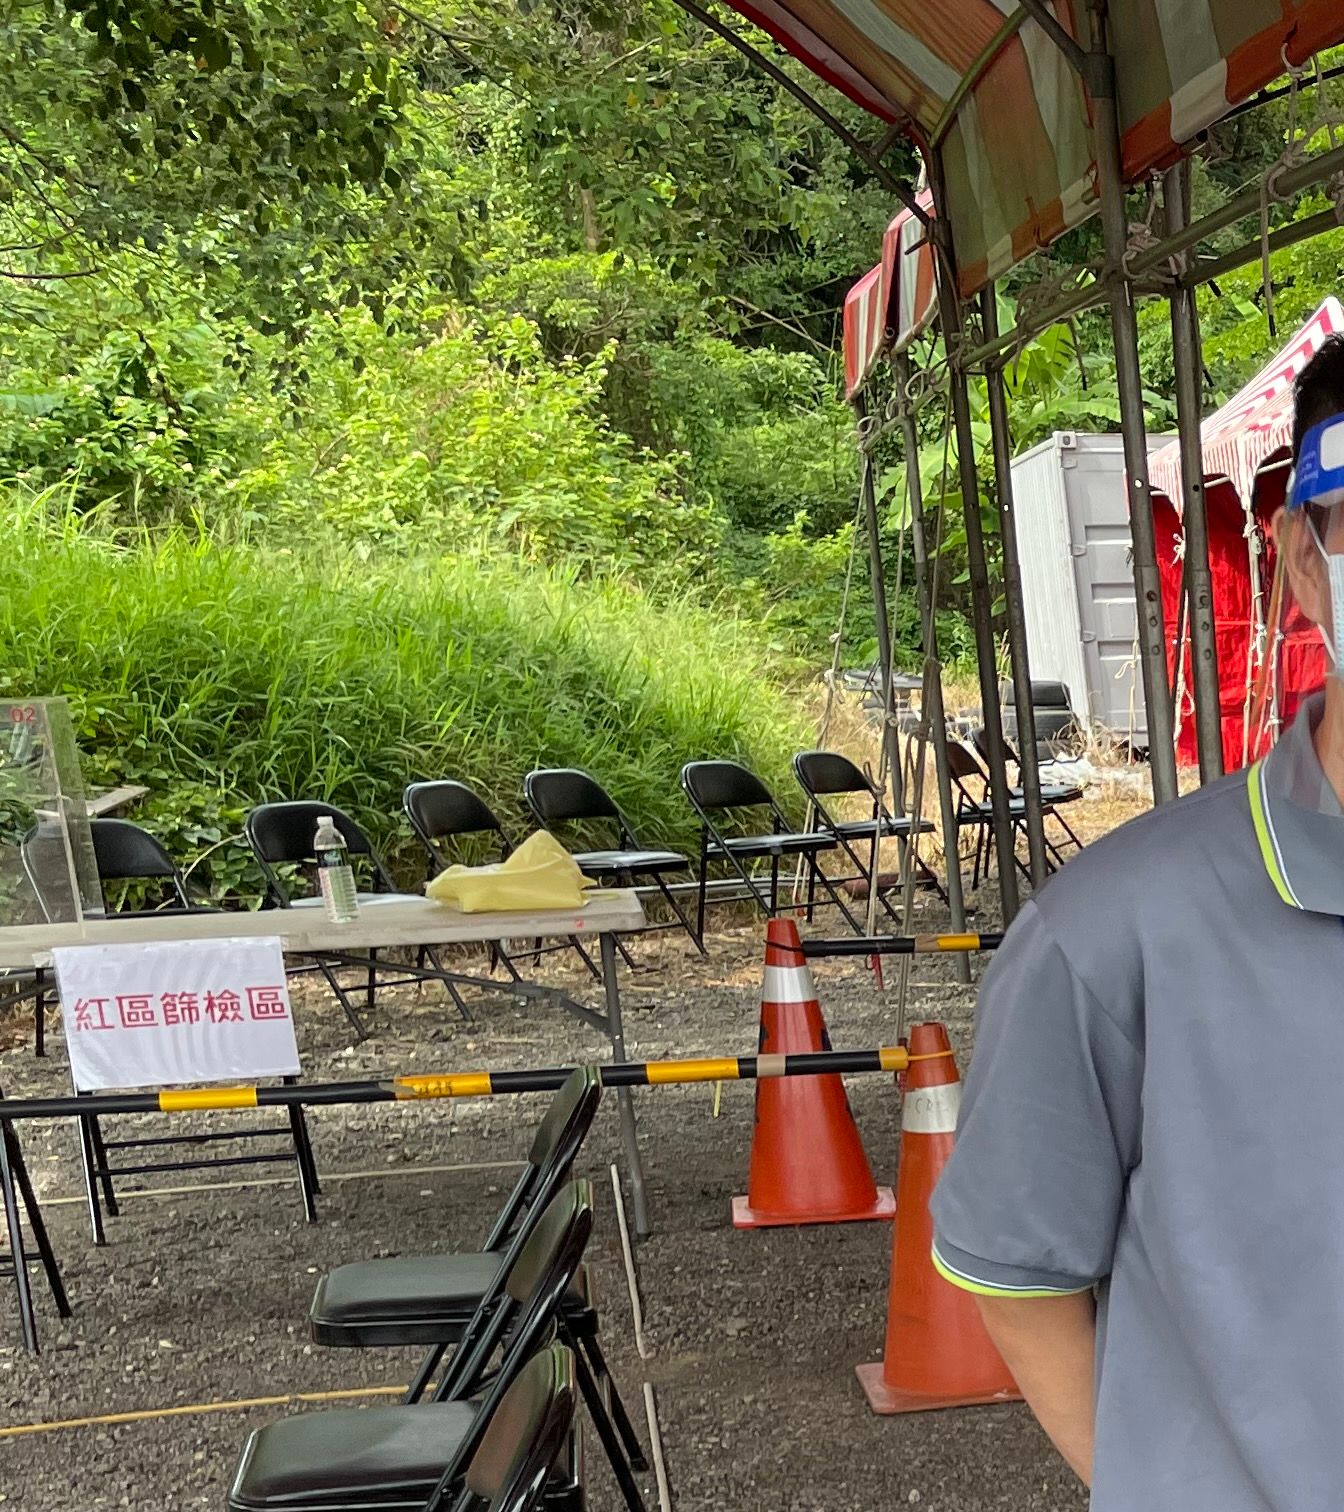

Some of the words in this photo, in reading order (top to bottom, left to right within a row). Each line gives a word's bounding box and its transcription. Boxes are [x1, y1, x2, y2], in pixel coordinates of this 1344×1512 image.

[74, 984, 289, 1033] 紅區篩檢區
